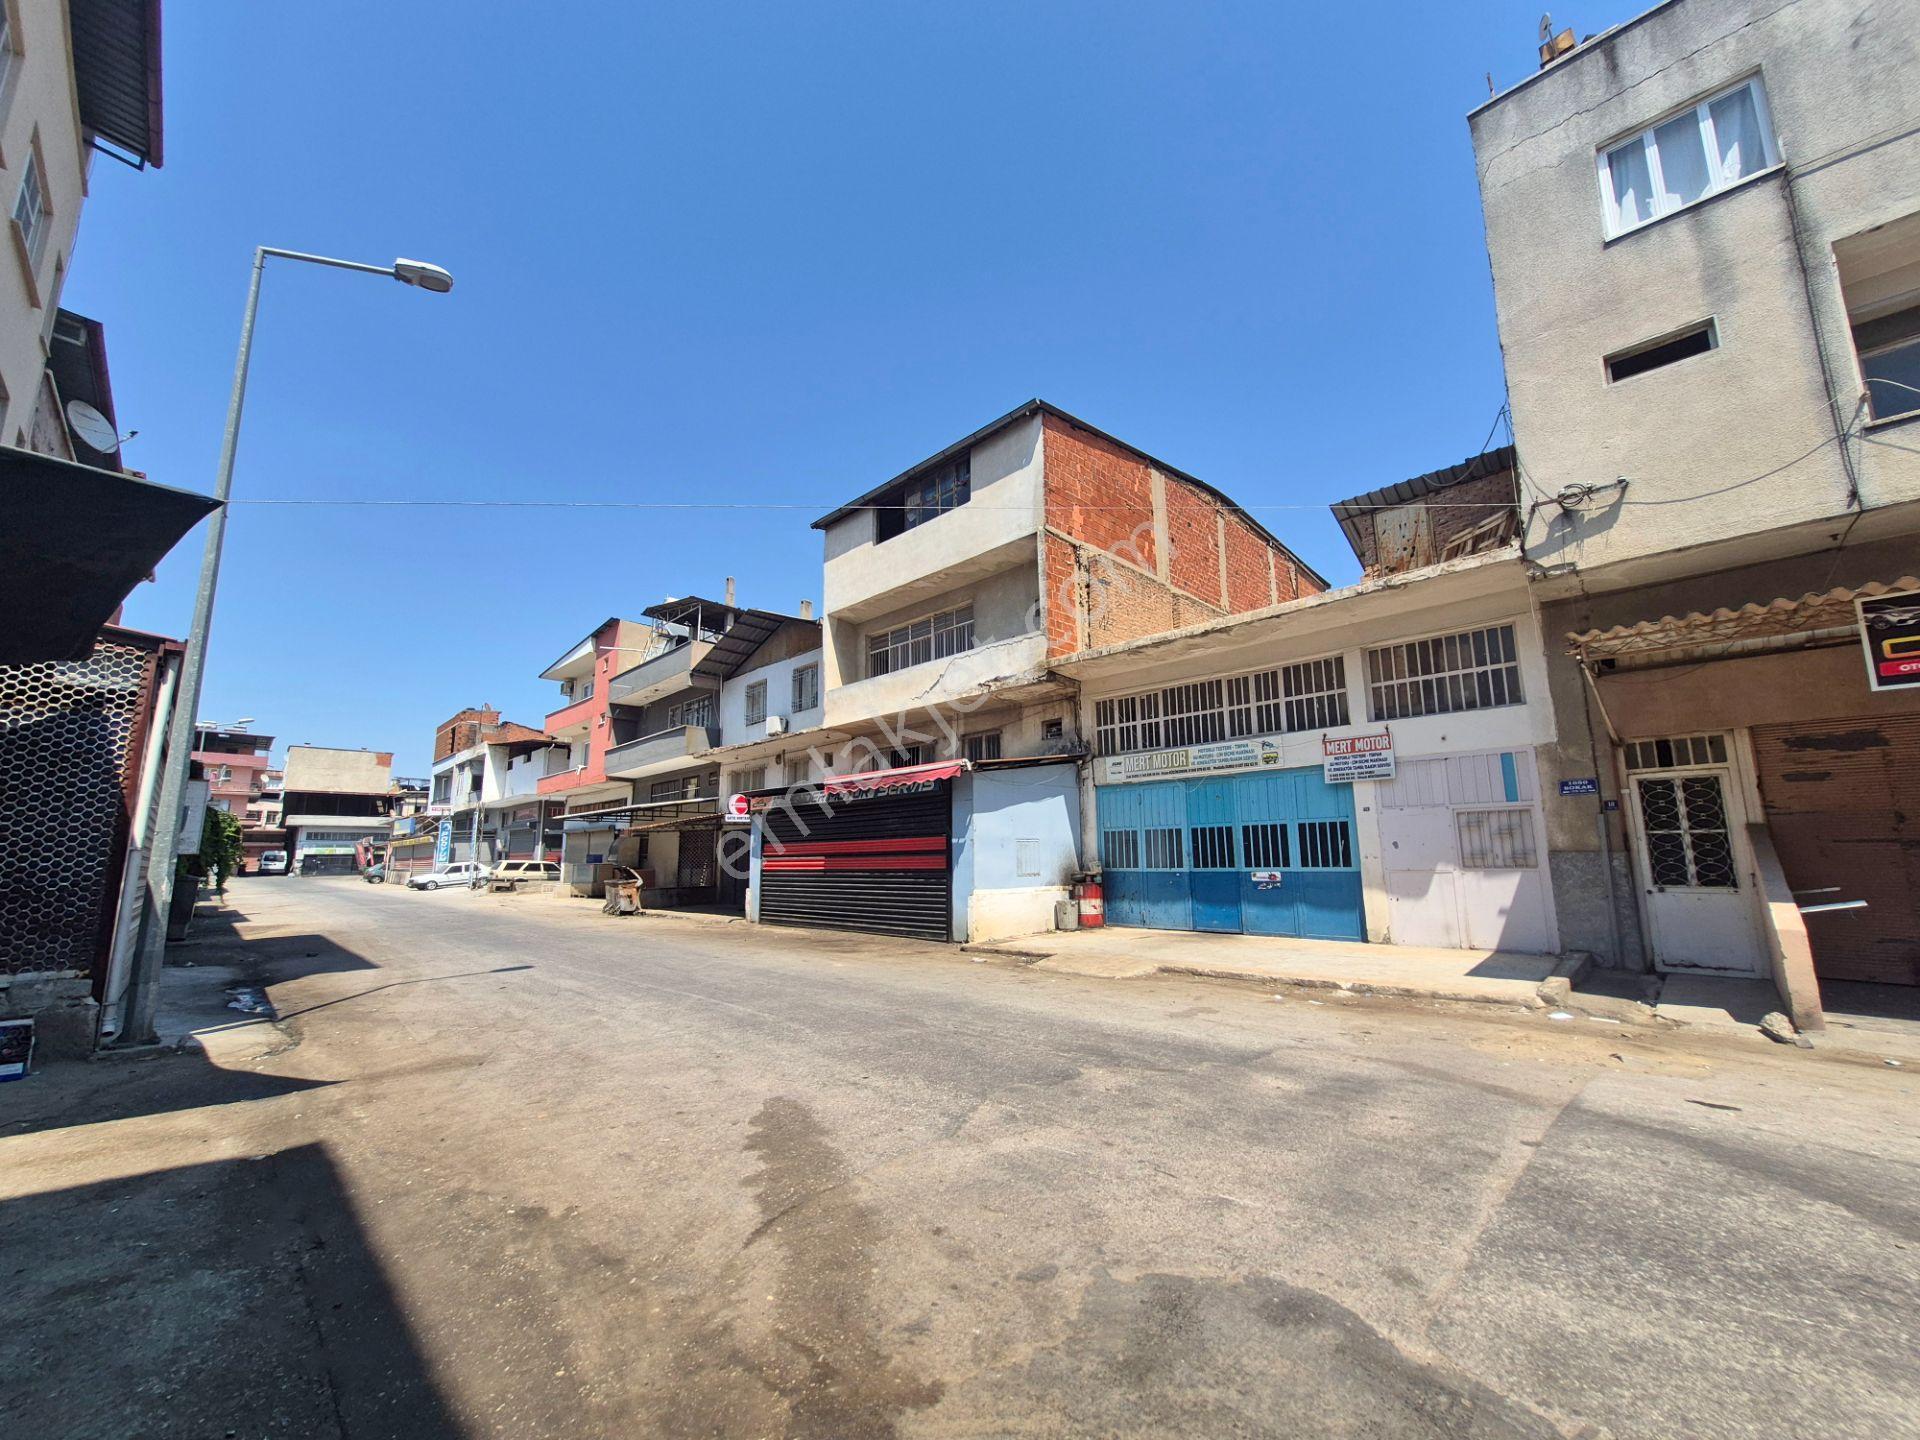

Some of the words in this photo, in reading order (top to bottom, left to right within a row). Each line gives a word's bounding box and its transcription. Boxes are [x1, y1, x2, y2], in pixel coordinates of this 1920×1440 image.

[1326, 740, 1352, 754] MERT
[1355, 735, 1390, 751] MOTOR
[1126, 755, 1151, 772] MERT
[1153, 751, 1187, 769] MOTOR
